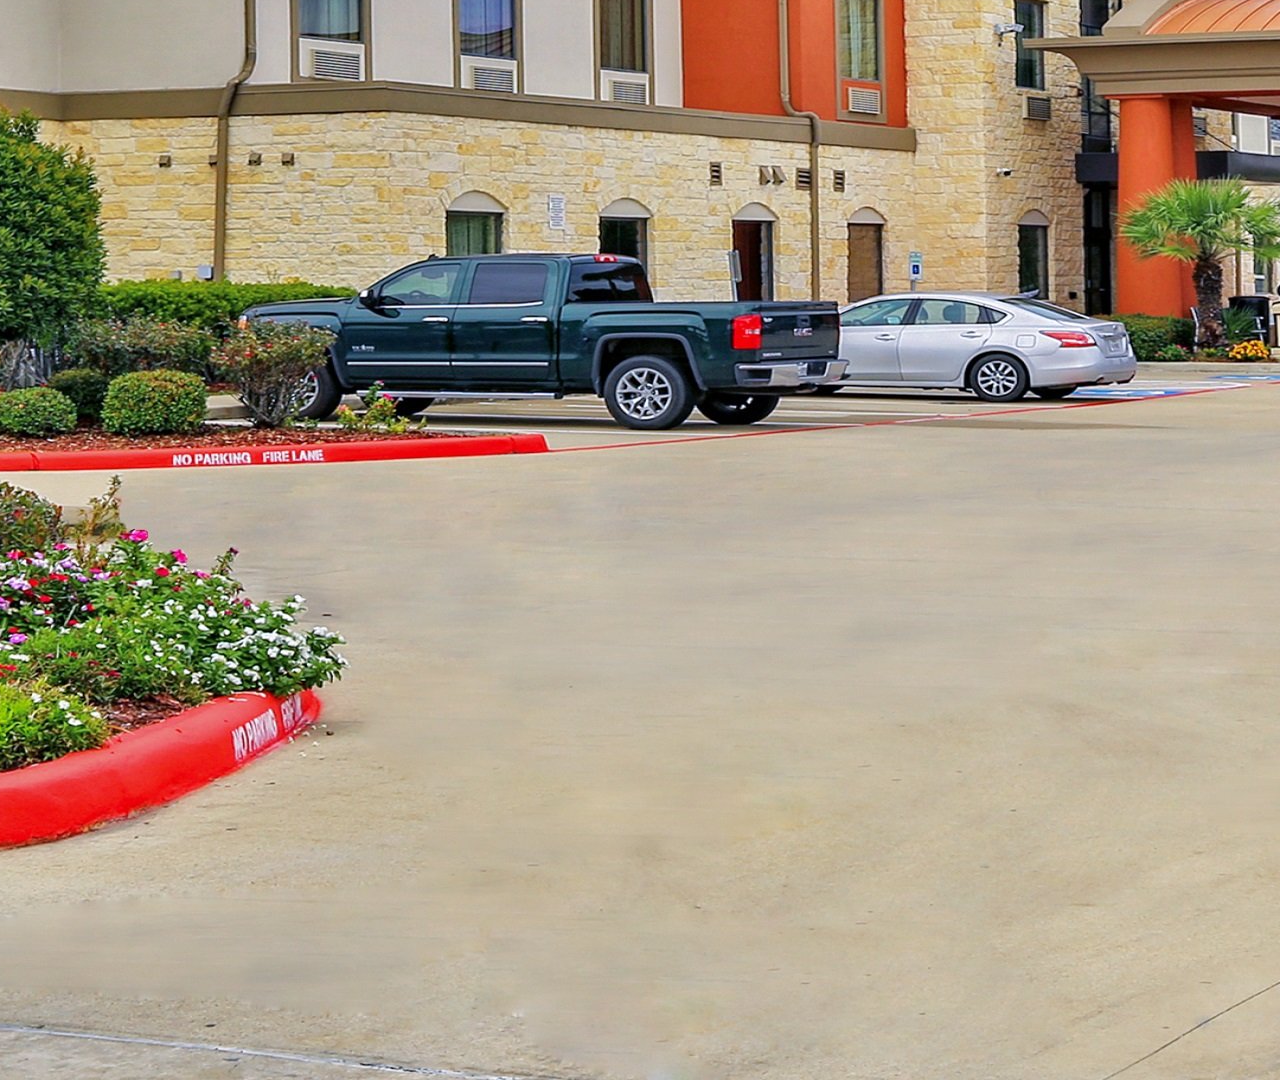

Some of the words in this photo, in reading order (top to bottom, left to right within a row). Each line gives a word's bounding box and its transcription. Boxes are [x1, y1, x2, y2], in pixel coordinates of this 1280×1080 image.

[172, 454, 192, 466] NO
[195, 452, 251, 465] PARKING
[262, 450, 290, 463] FIRE
[292, 449, 324, 462] LANE
[232, 726, 248, 761] NO
